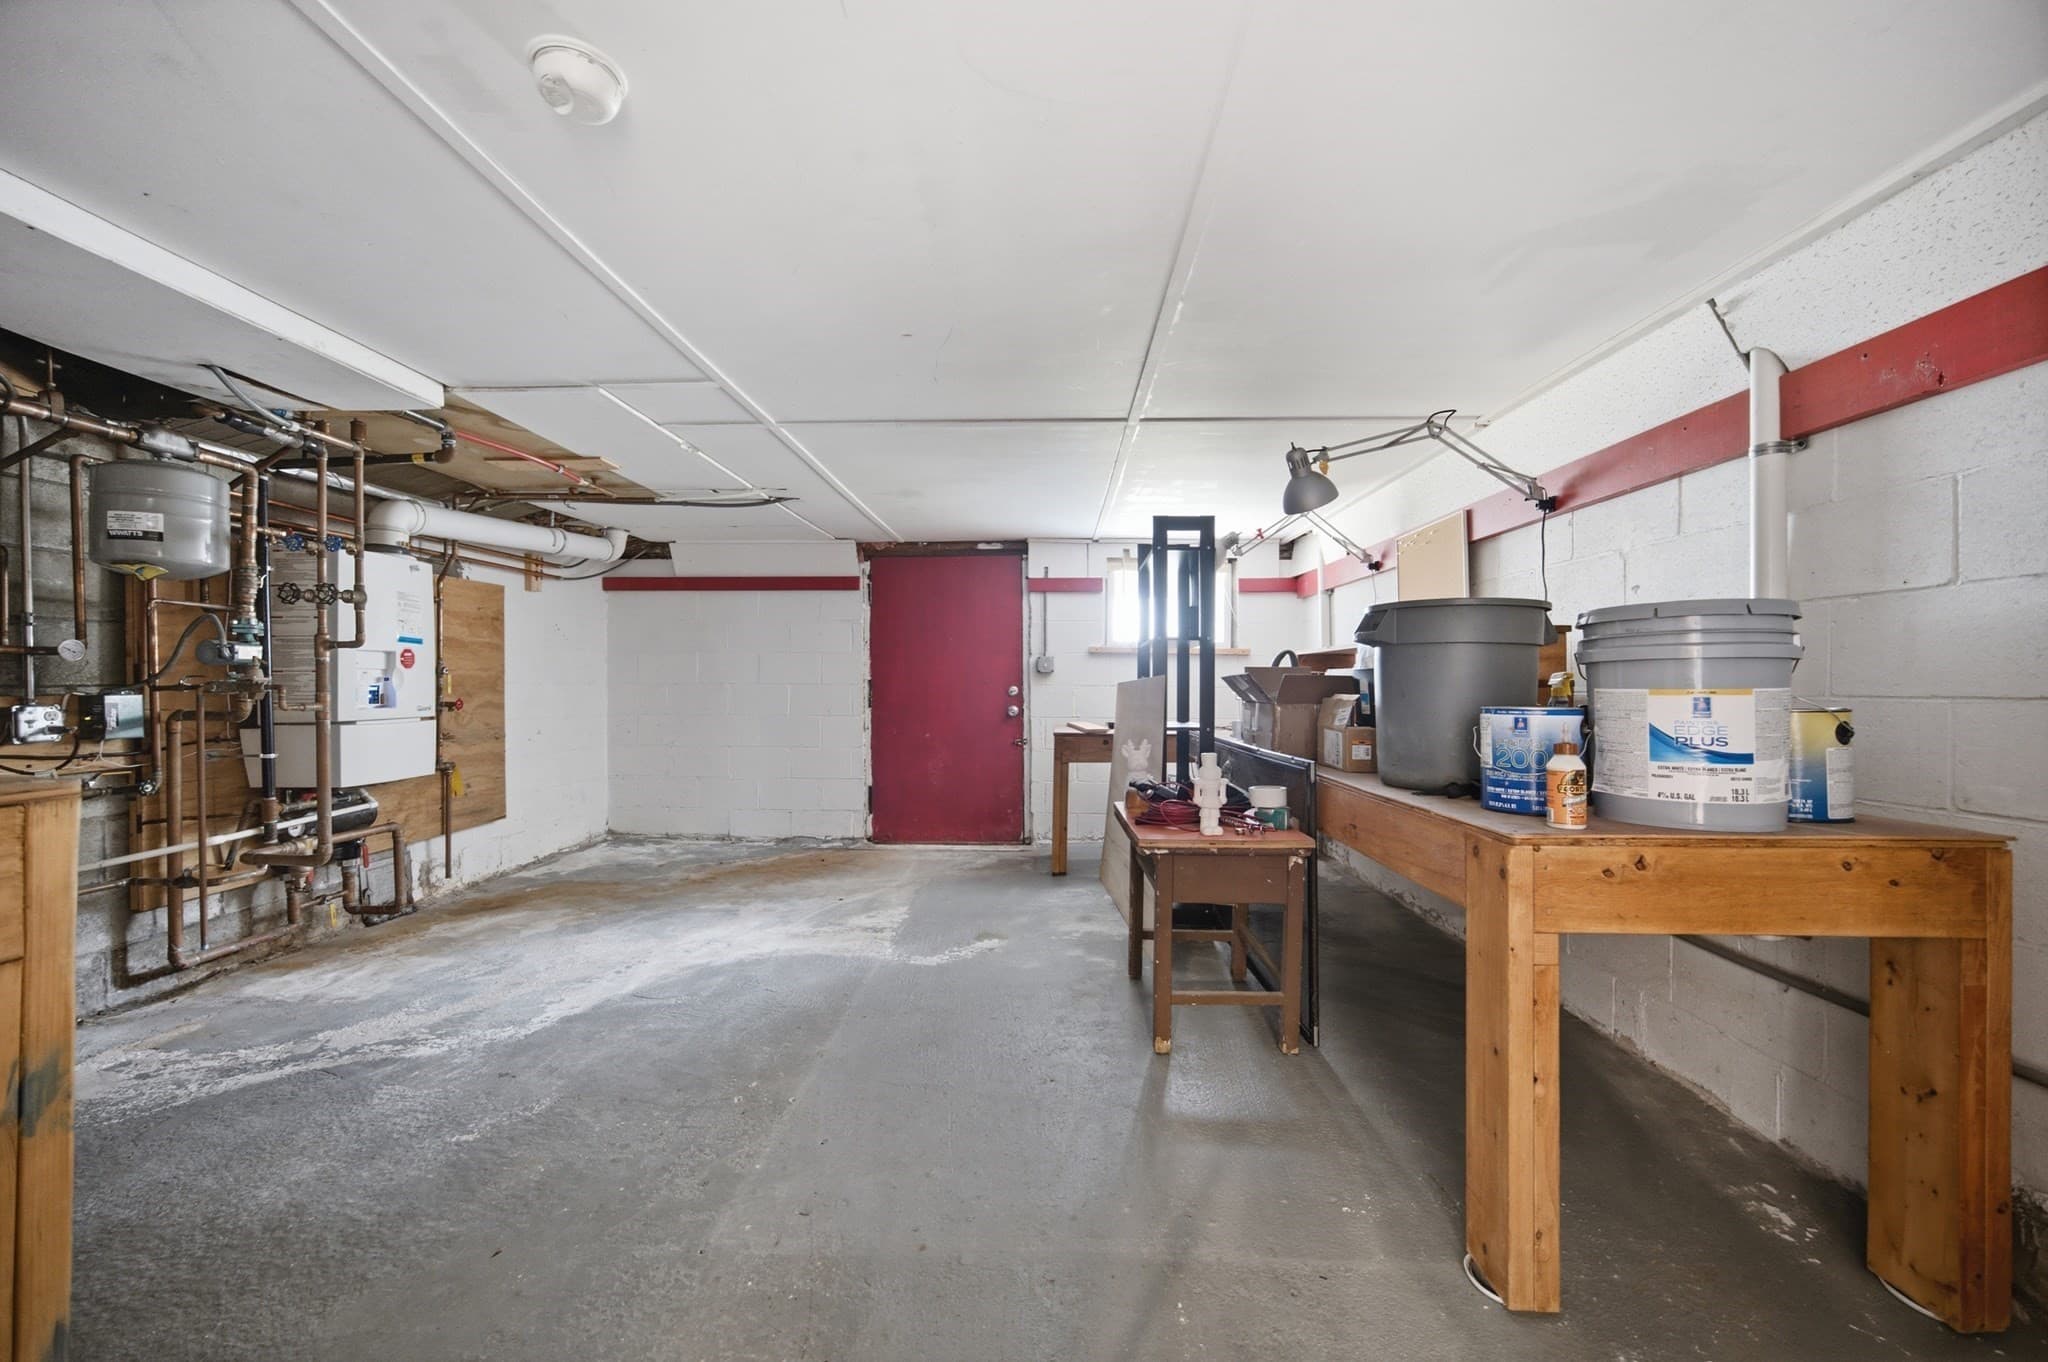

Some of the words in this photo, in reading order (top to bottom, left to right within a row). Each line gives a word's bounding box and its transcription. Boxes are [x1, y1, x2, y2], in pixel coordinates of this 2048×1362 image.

[1674, 725, 1729, 736] EDGE
[1675, 736, 1729, 747] PLUS
[1495, 748, 1549, 769] 200
